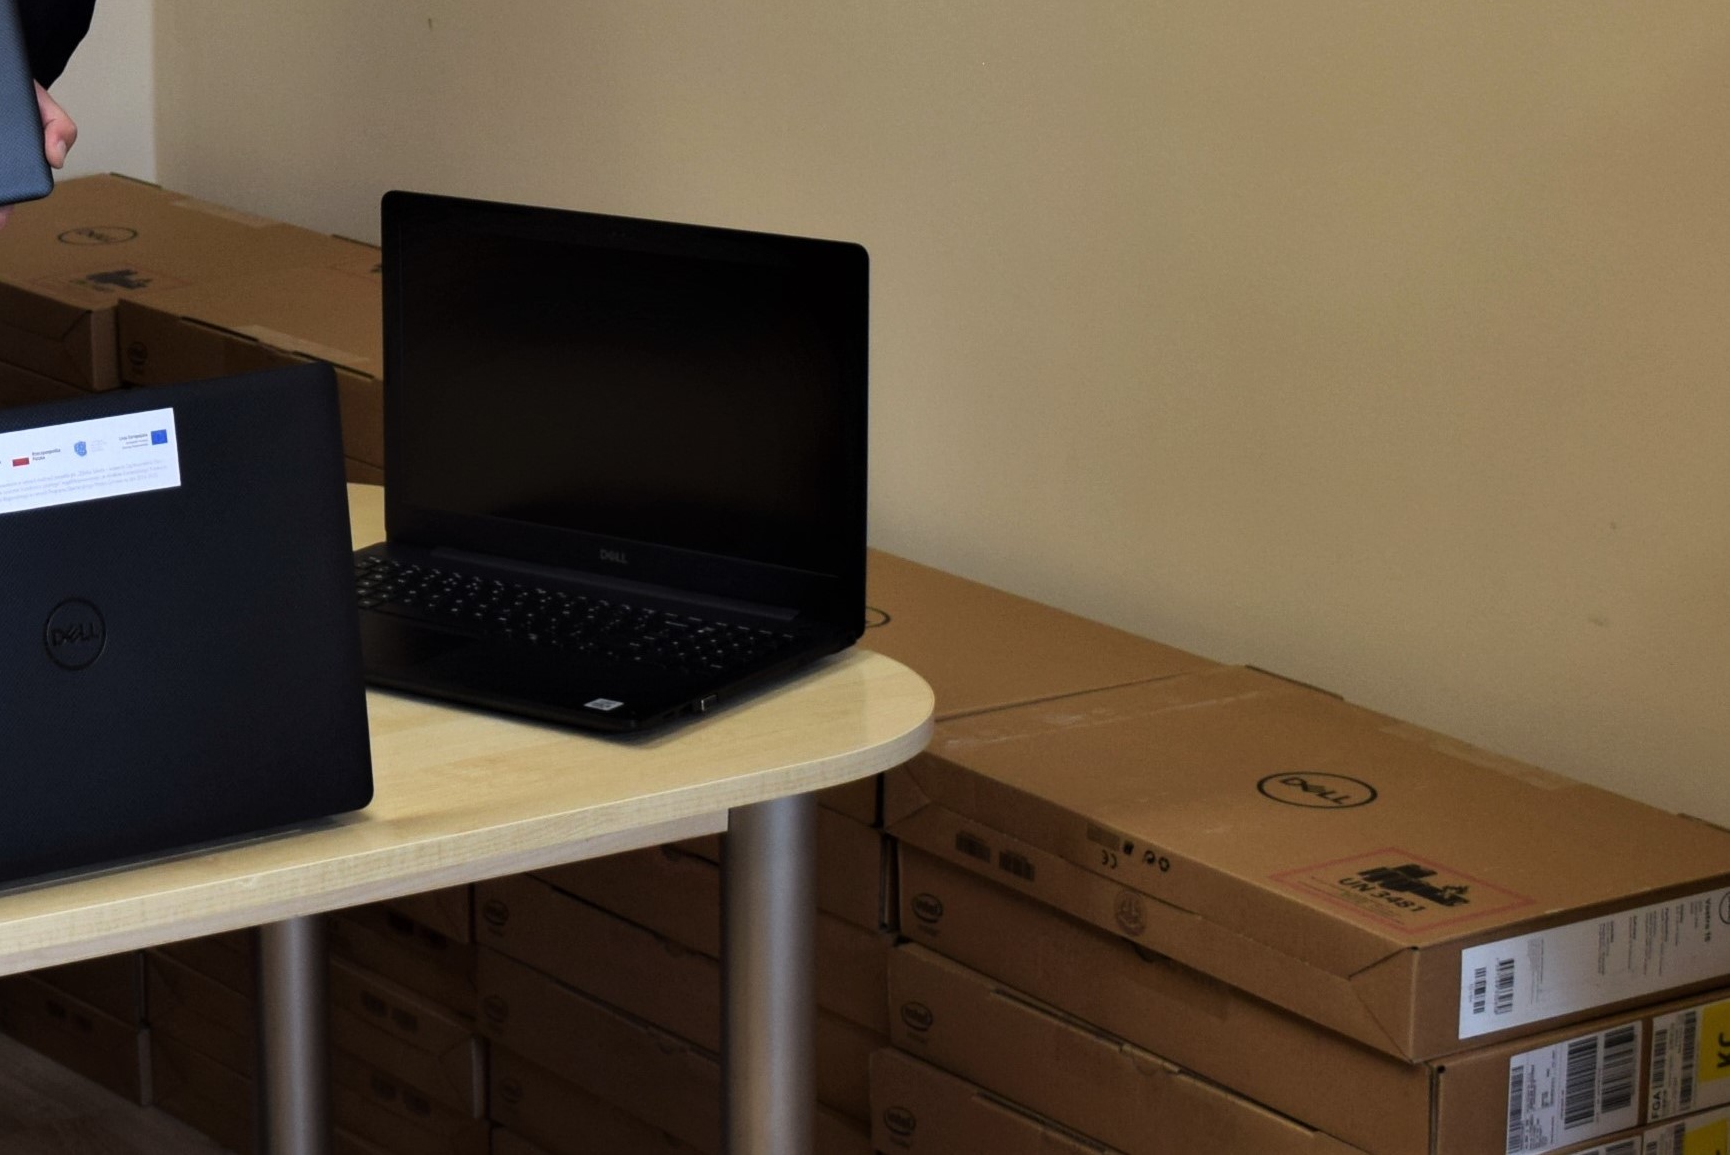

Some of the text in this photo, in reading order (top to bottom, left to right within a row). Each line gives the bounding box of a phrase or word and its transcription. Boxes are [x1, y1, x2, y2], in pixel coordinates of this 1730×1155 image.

[599, 548, 629, 564] DELL
[51, 623, 99, 647] DELL
[1279, 777, 1350, 804] DELL
[1338, 877, 1427, 913] UN 3481
